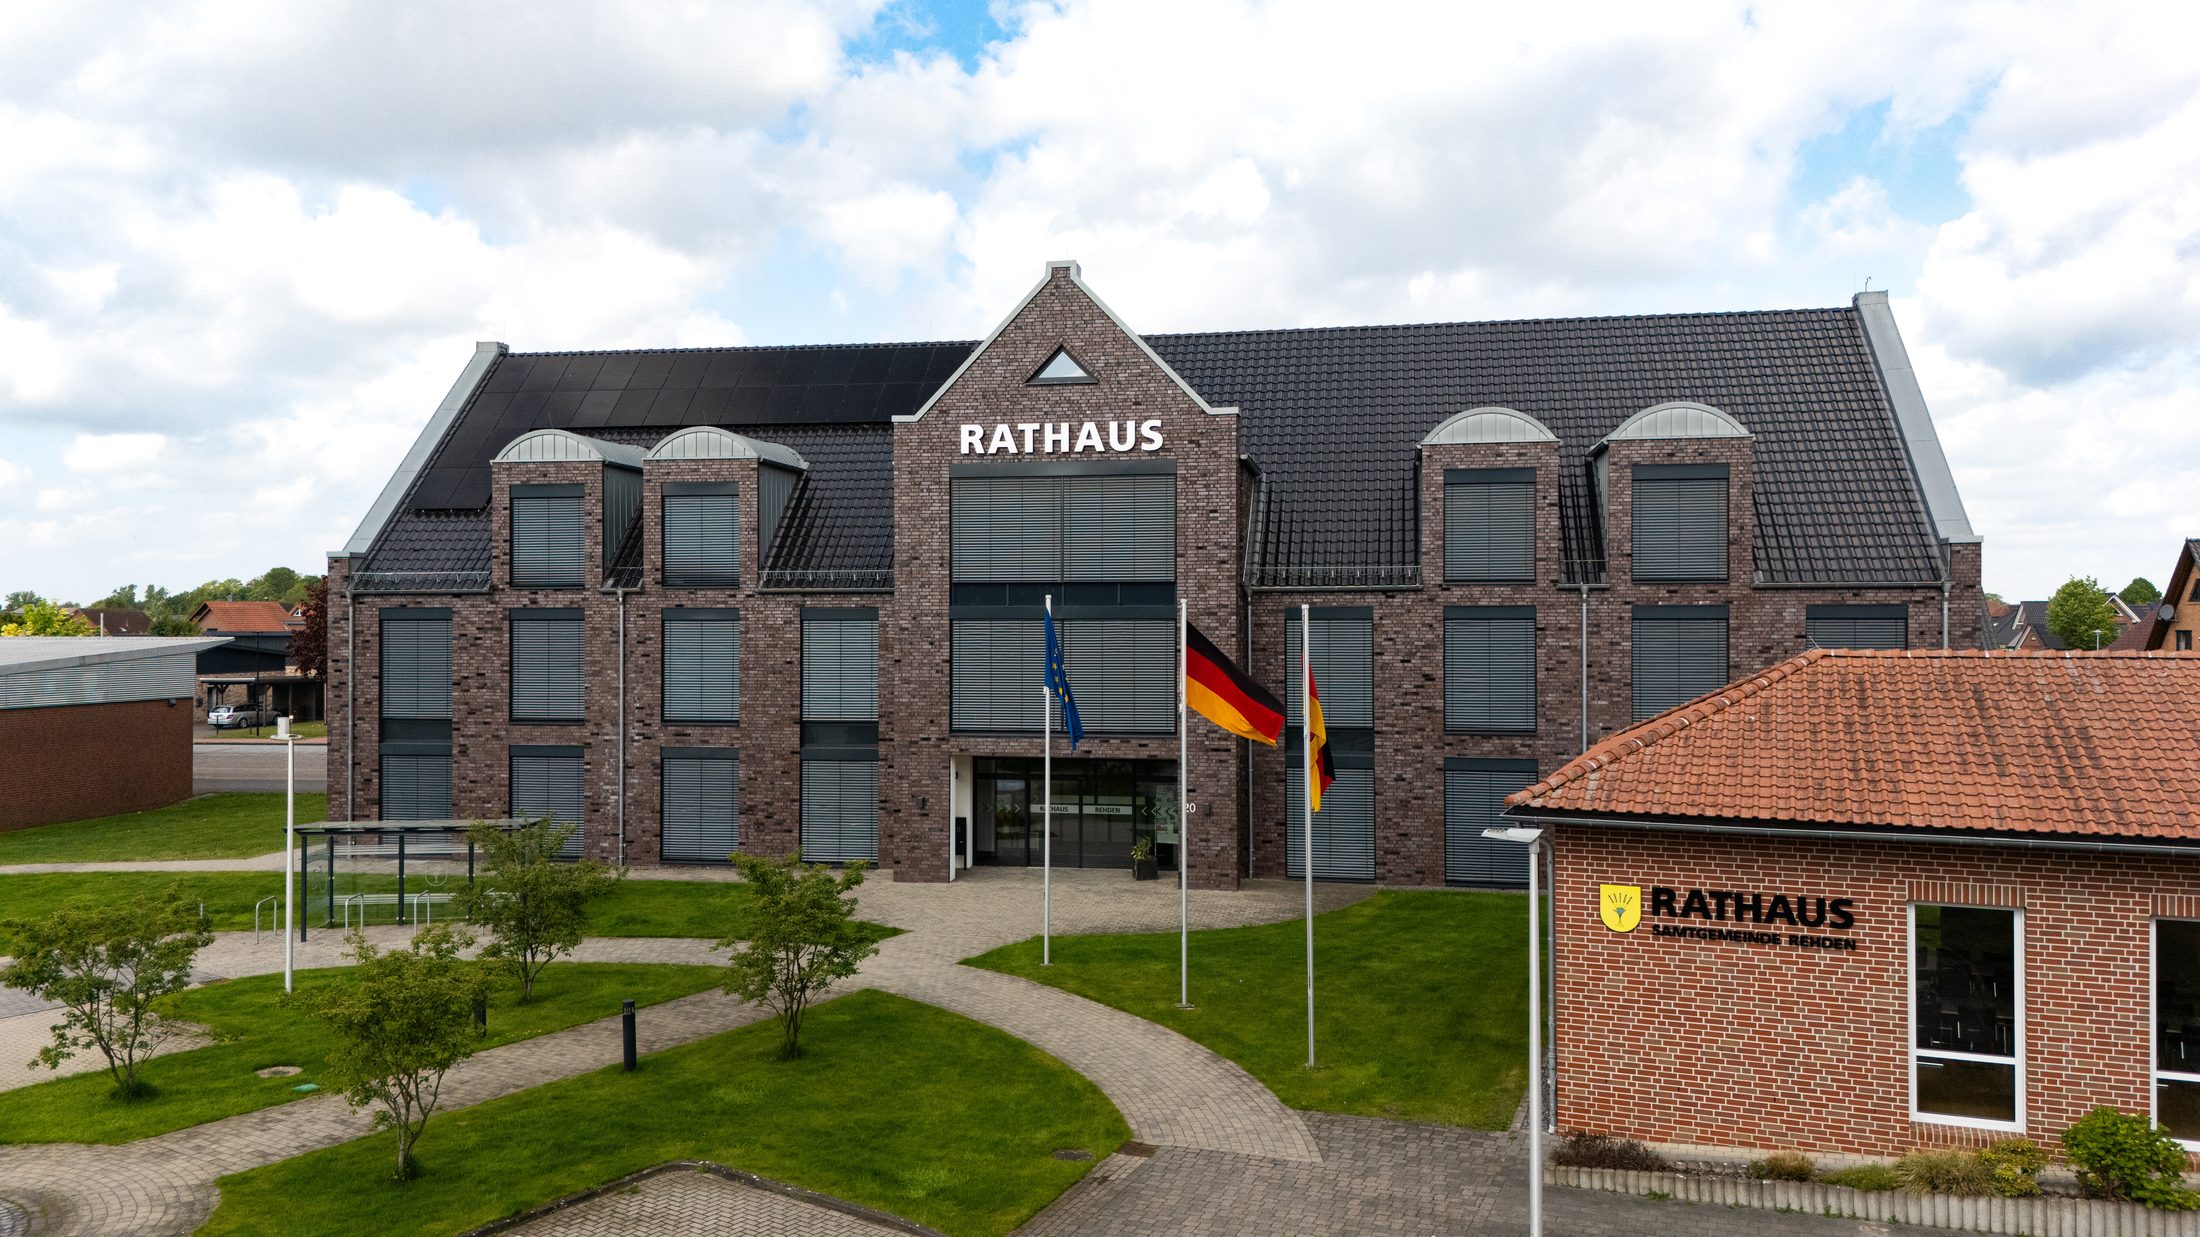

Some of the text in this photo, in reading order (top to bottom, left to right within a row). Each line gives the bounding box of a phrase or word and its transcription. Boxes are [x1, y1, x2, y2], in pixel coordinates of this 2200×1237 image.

[960, 419, 1164, 455] RATHAUS
[1651, 887, 1855, 929] RATHAUS
[1652, 924, 1857, 951] SAMTGEMEINDE REHDEN
